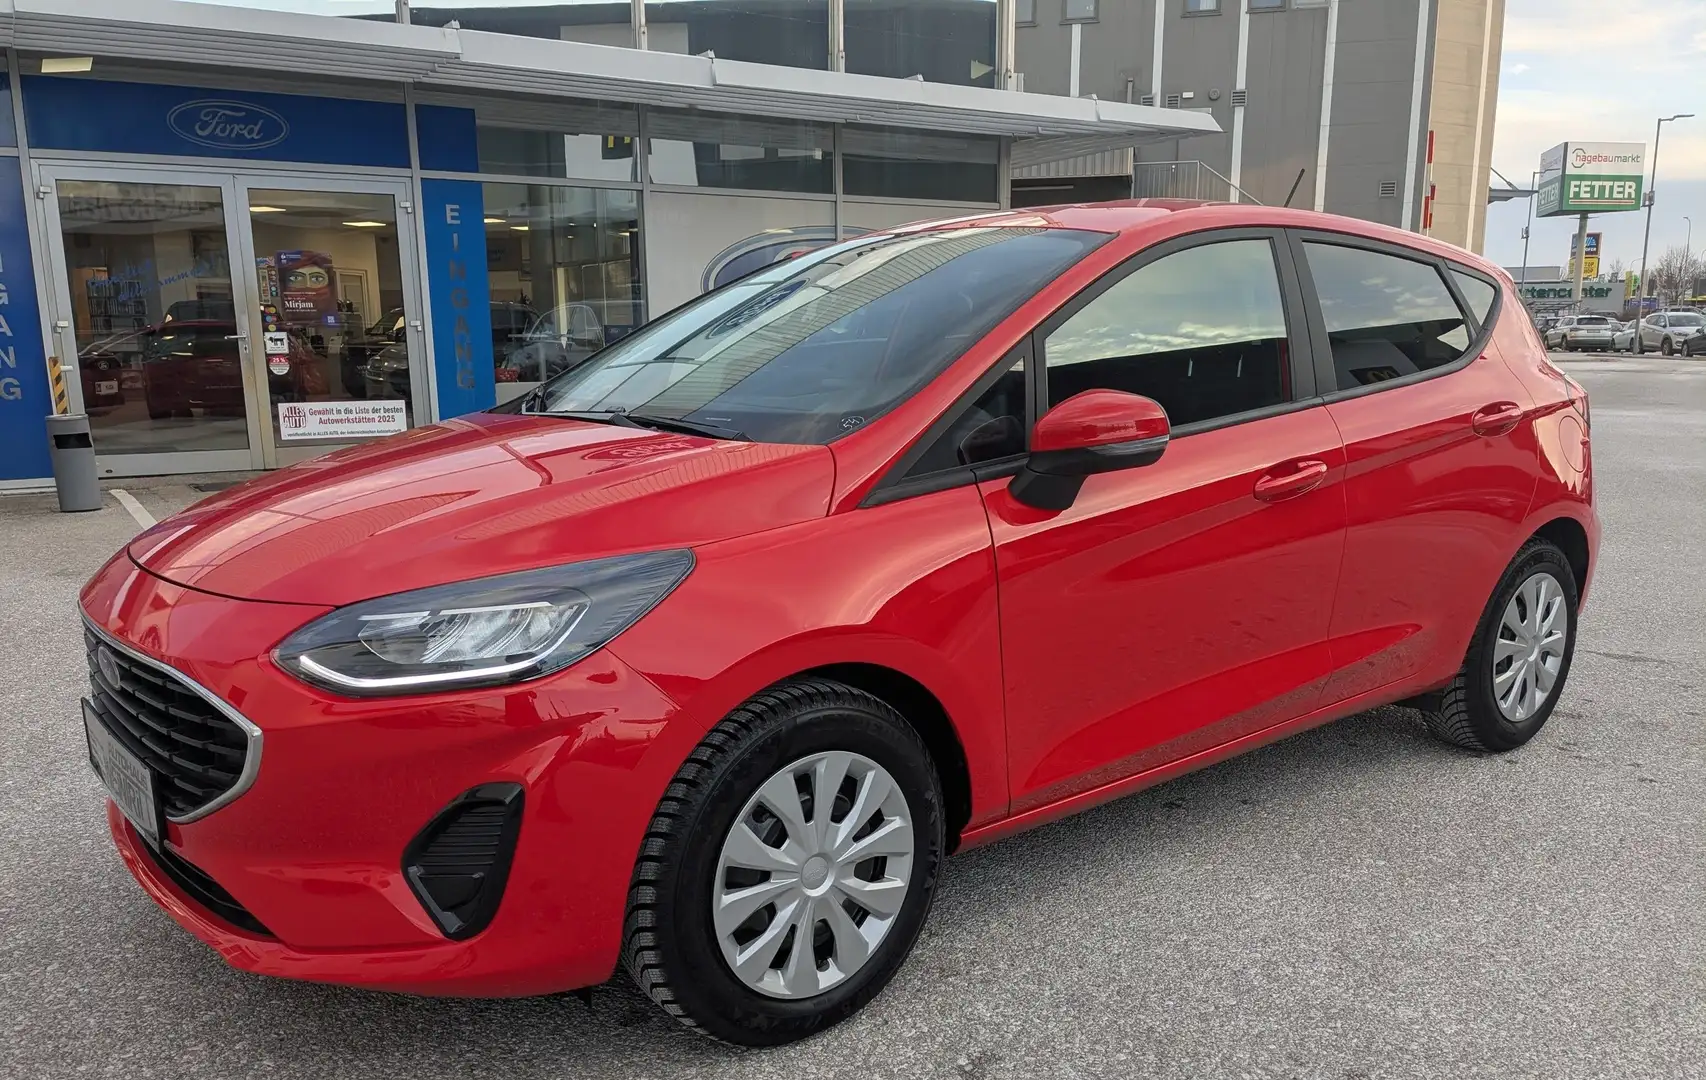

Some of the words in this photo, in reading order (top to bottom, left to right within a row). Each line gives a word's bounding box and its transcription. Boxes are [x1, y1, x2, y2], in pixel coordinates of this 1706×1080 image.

[195, 108, 264, 139] Ford
[1575, 153, 1641, 164] hagebaumarkt
[1540, 181, 1559, 205] FETTER
[1569, 180, 1637, 198] FETTER
[445, 203, 475, 390] EINGANG
[284, 300, 313, 309] Mirjam
[283, 405, 305, 417] ALLES
[308, 407, 335, 416] Gewählt
[335, 407, 342, 415] in
[343, 406, 354, 415] die
[355, 406, 370, 414] Liste
[371, 406, 381, 414] der
[382, 405, 404, 413] besten
[283, 416, 307, 428] AUTO
[318, 416, 376, 425] Autowerkstätten
[377, 415, 396, 423] 2025
